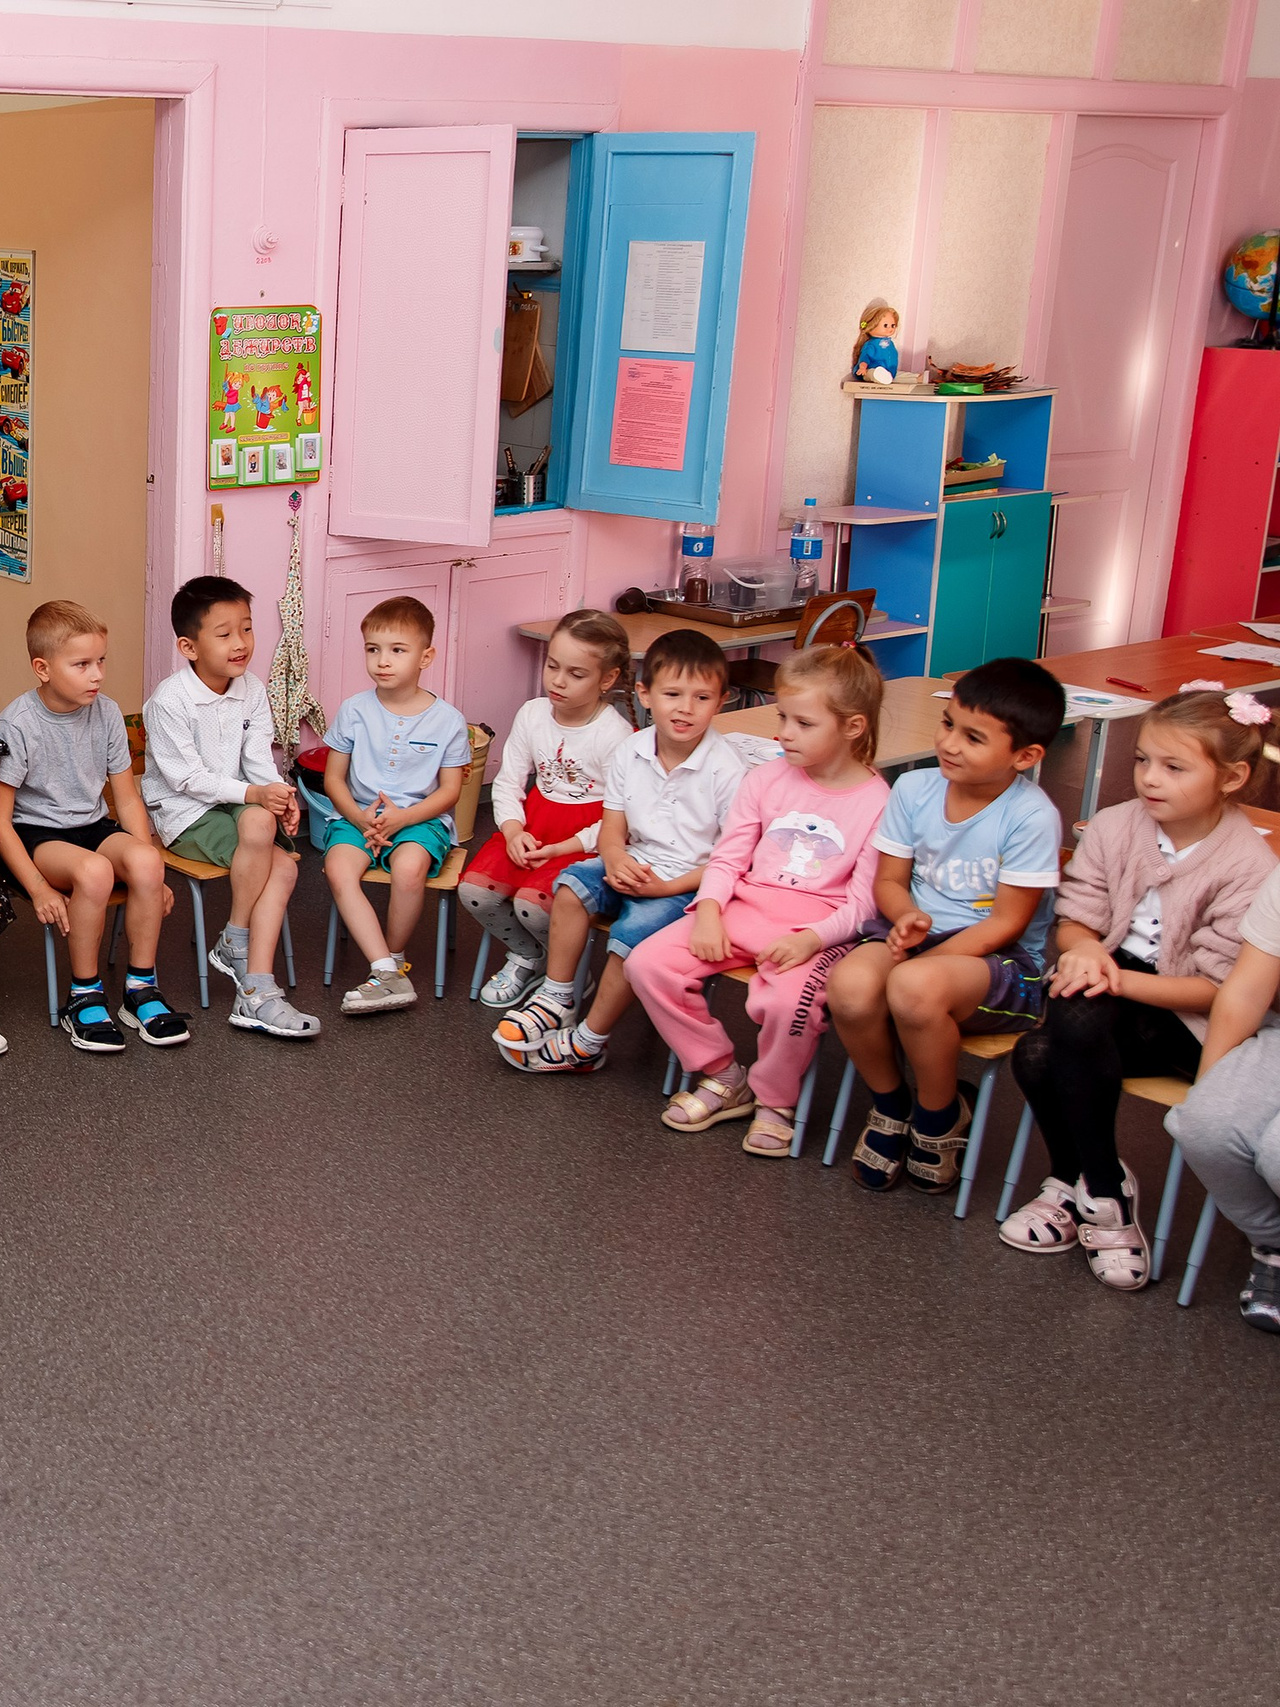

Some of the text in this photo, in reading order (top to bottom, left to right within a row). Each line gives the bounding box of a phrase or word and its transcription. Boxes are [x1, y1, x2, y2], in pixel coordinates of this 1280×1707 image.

[219, 336, 317, 361] ДЕЖУРСТВ
[1093, 722, 1101, 735] 2
[788, 973, 826, 1037] Famous
